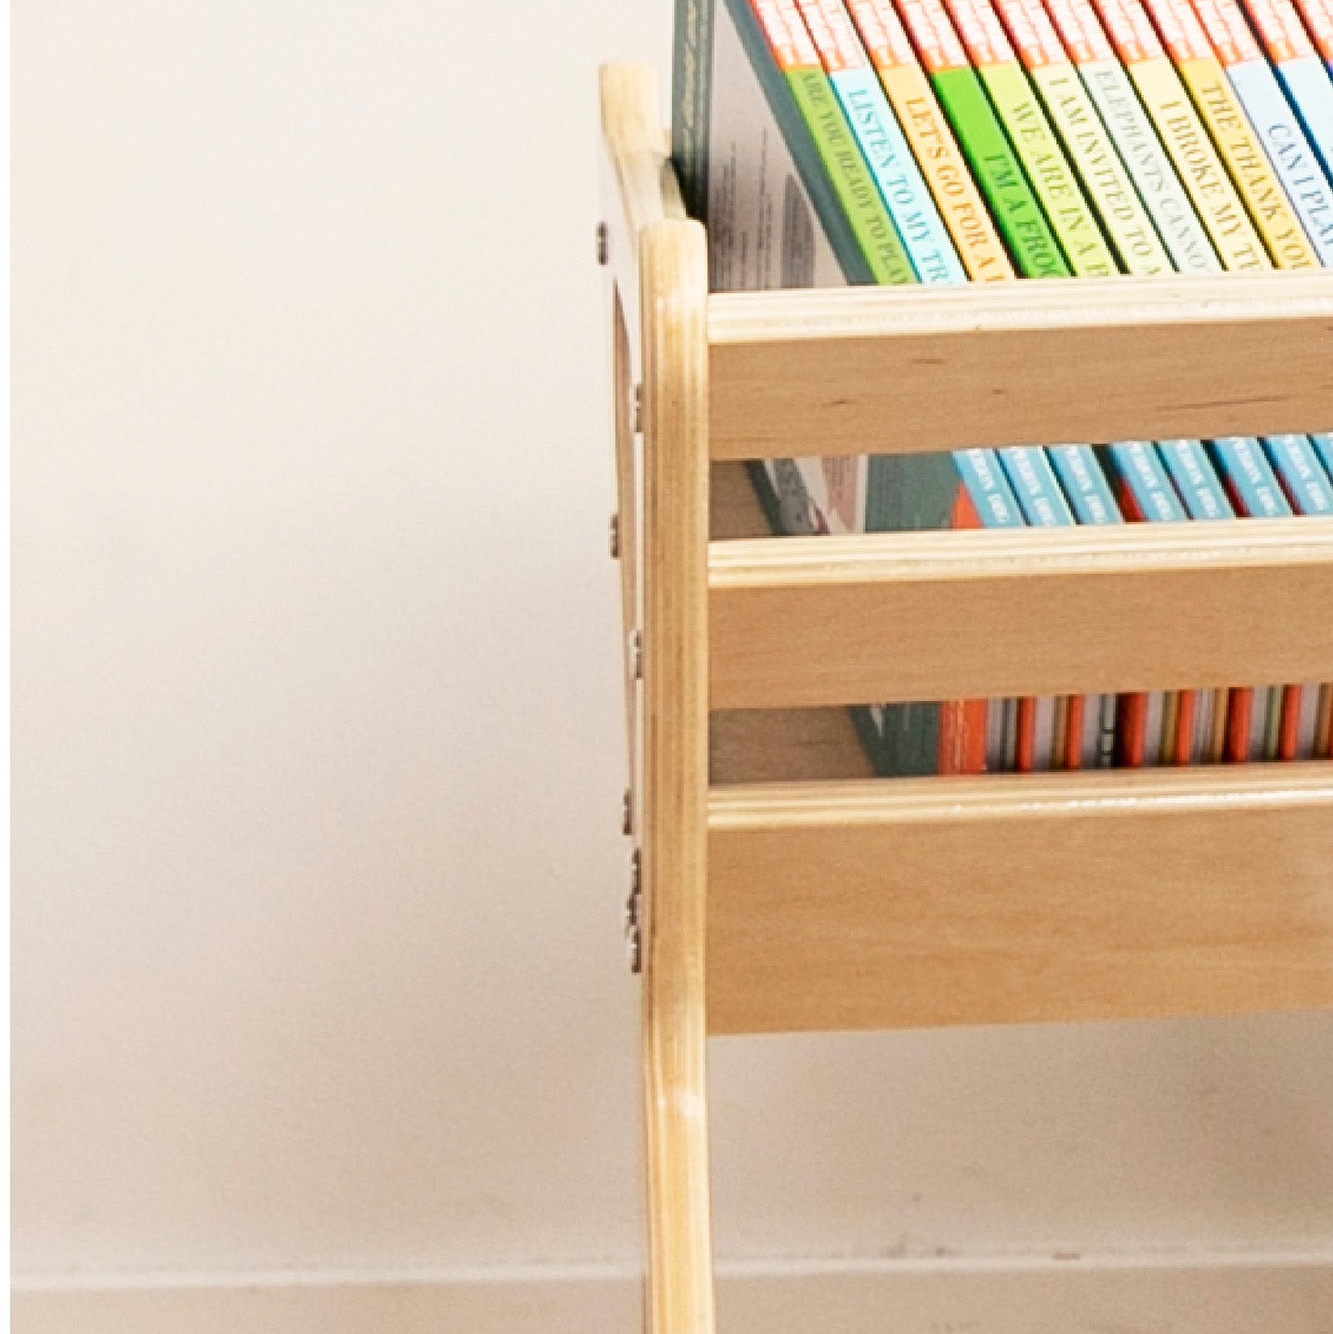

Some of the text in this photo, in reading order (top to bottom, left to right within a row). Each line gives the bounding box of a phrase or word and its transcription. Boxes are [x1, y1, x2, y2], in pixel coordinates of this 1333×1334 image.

[801, 73, 825, 106] ARE
[835, 151, 872, 208] READY
[865, 215, 887, 239] TO
[848, 90, 898, 168] LISTEN
[887, 179, 915, 204] TO
[906, 211, 934, 242] MY
[906, 97, 949, 160] LET'S
[936, 165, 966, 197] GO
[952, 203, 989, 248] FOR
[1011, 102, 1046, 142] WE
[1034, 153, 1071, 199] ARE
[1058, 96, 1088, 125] AM
[1077, 131, 1135, 221] INVITED
[1125, 228, 1153, 257] TO
[1094, 70, 1165, 191] ELEPHANTS
[1166, 116, 1224, 198] BROKE
[1210, 202, 1245, 237] MY
[1202, 82, 1242, 131] THE
[1229, 140, 1283, 221] THANK
[1268, 123, 1307, 171] CAN
[983, 154, 1019, 189] I'M
[1004, 198, 1027, 213] A
[1059, 206, 1090, 233] IN
[1073, 241, 1098, 256] A
